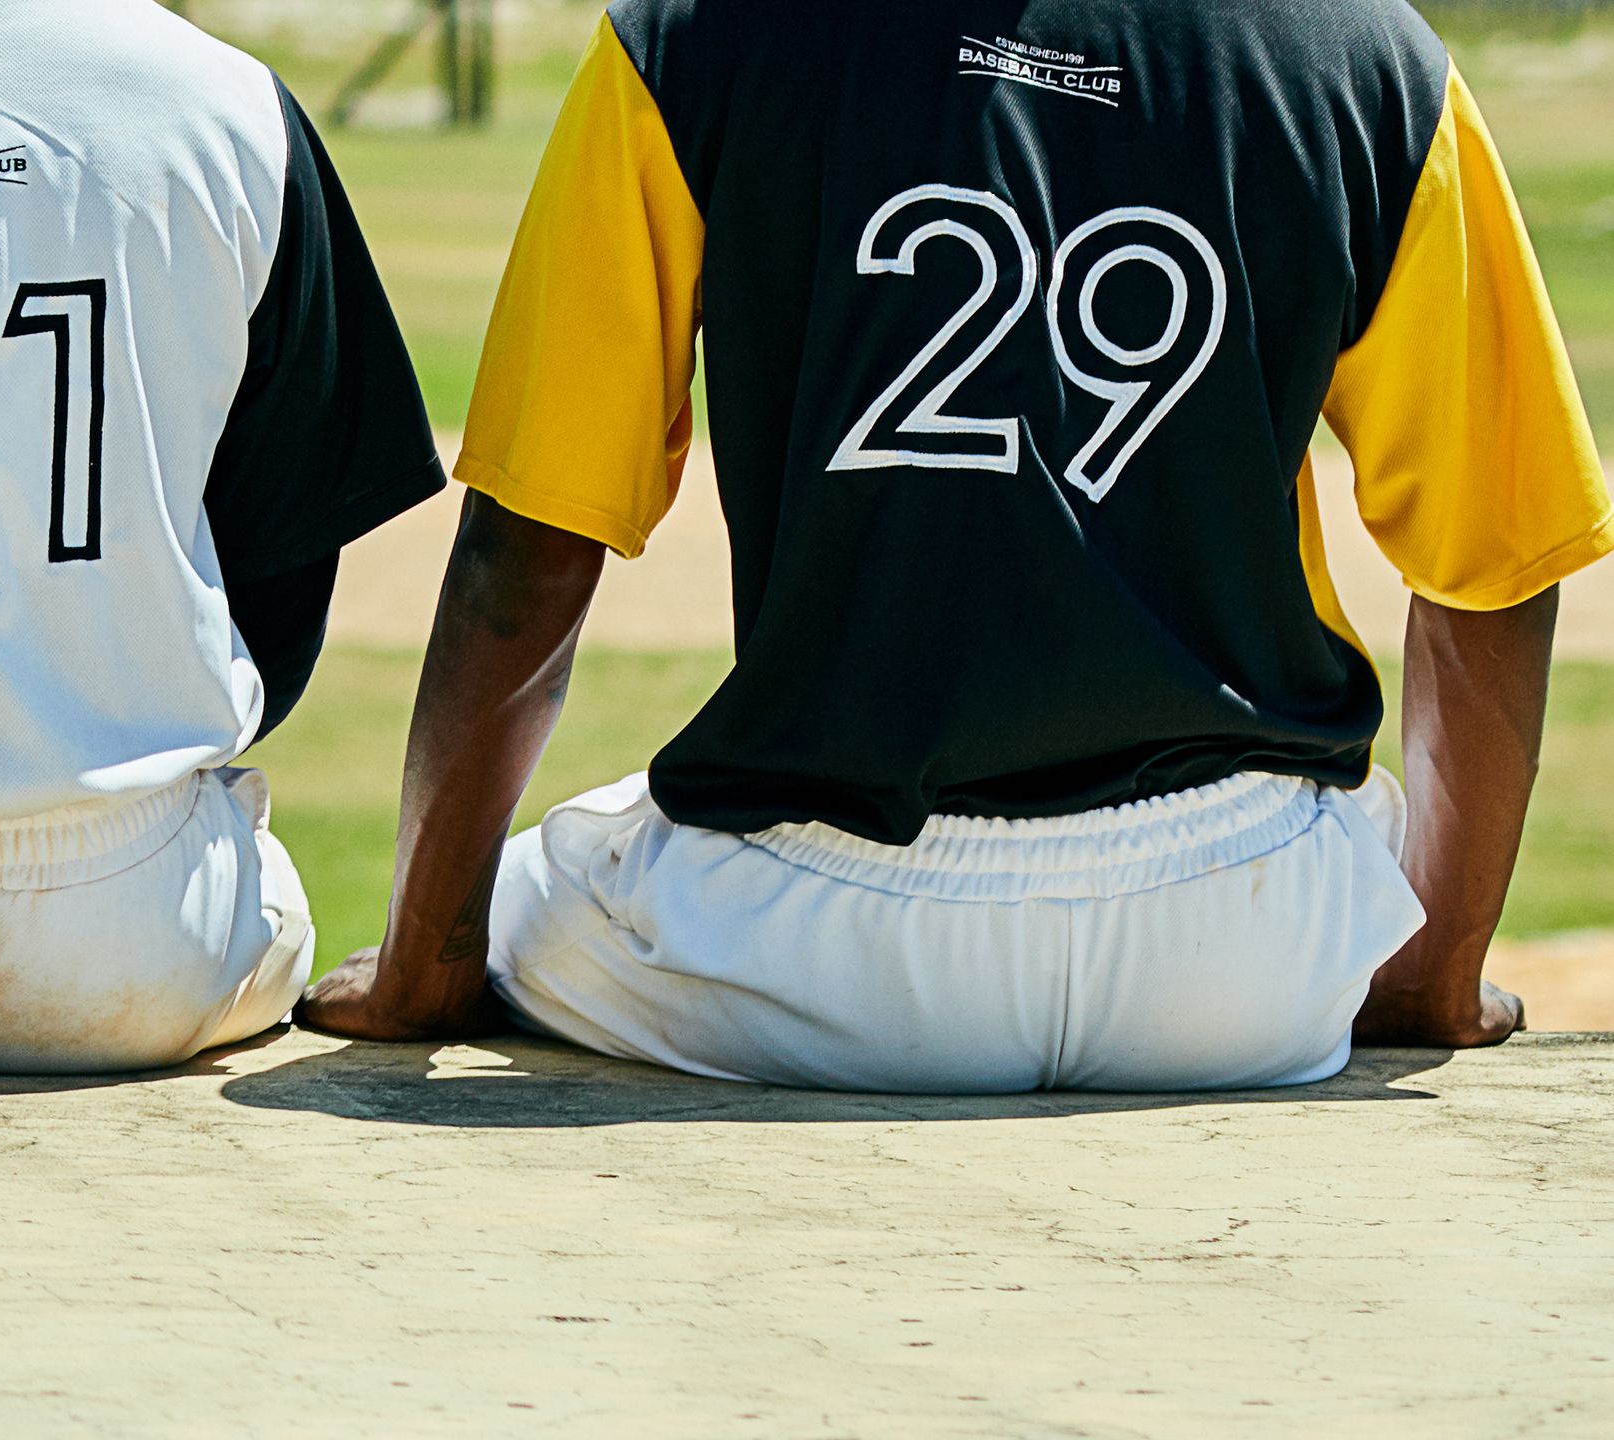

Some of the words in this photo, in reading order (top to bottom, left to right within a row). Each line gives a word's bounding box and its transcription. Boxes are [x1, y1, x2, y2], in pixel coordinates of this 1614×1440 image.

[959, 48, 1058, 85] BASEBALL
[1063, 72, 1121, 94] CLUB
[826, 183, 1228, 504] 29
